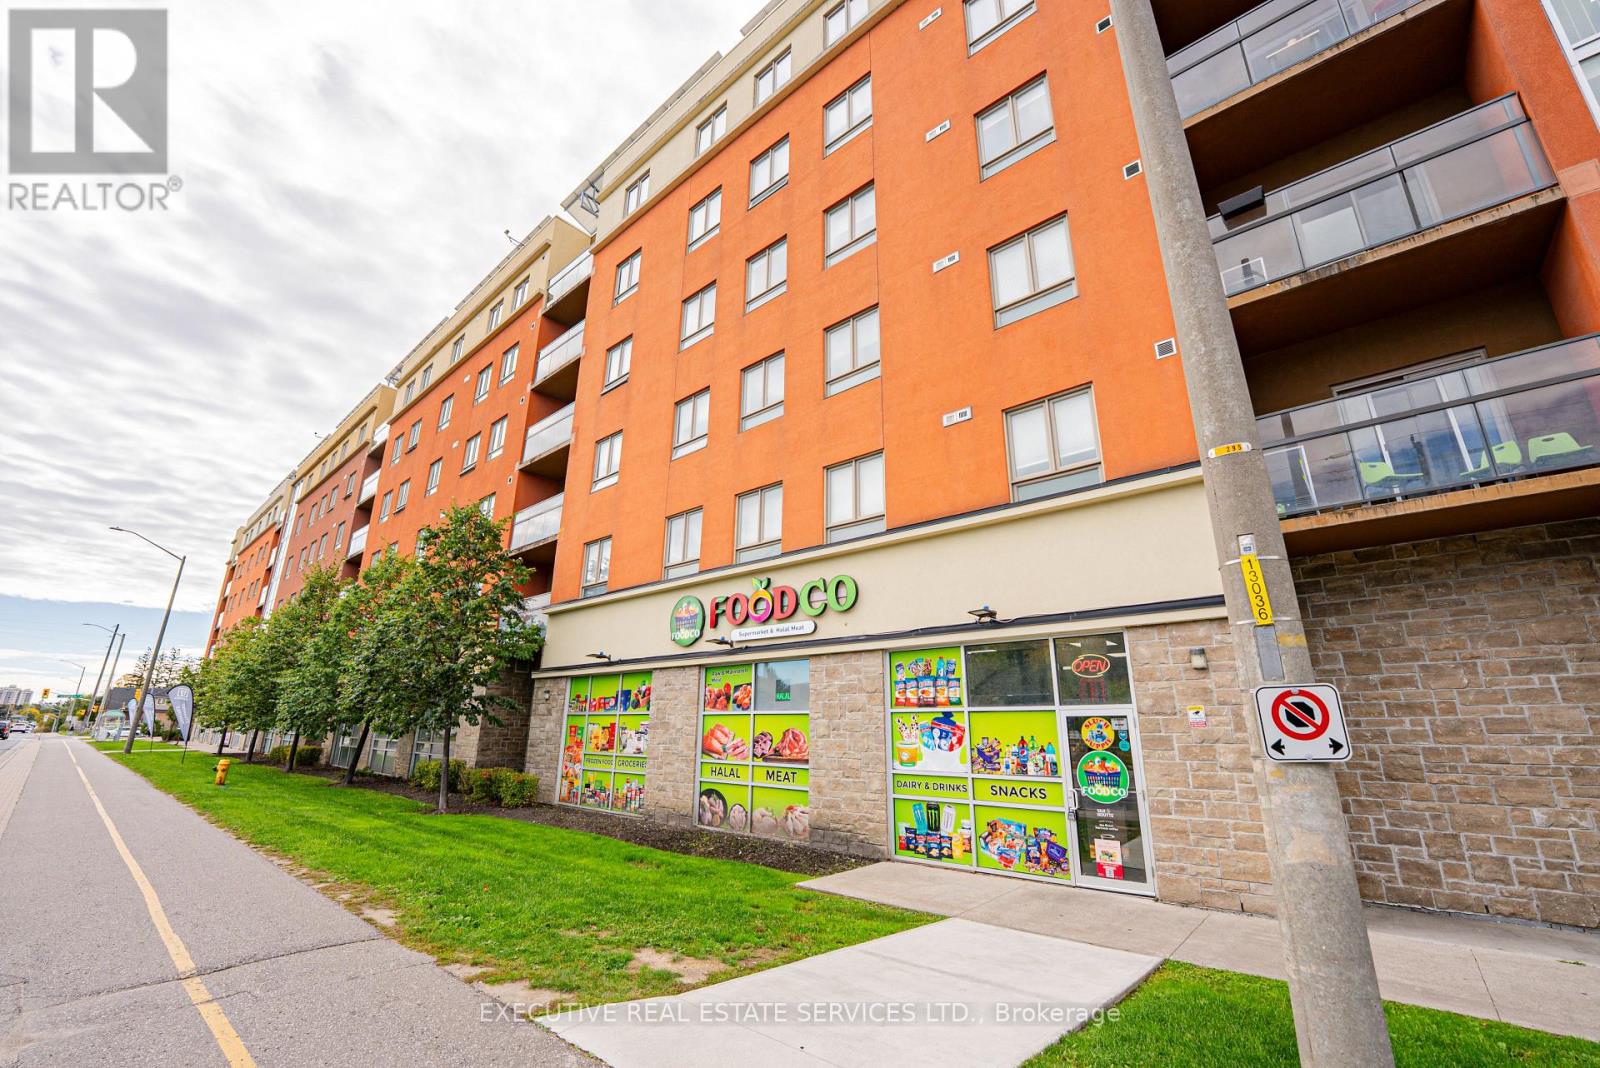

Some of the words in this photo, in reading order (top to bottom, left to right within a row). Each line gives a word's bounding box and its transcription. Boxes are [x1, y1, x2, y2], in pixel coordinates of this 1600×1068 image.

[1227, 444, 1242, 453] 295
[1246, 558, 1269, 621] 13036
[709, 574, 859, 629] FOODCO
[671, 629, 701, 641] FOODCO
[738, 628, 769, 637] Supermarket
[776, 626, 790, 634] Halal
[791, 624, 805, 632] Meat
[1073, 659, 1107, 673] OPEN
[710, 766, 741, 780] HALAL
[765, 769, 798, 784] MEAT
[896, 780, 922, 790] DAIRY
[924, 782, 930, 790] &
[932, 782, 968, 793] DRINKS
[990, 784, 1047, 800] SNACKS
[1082, 786, 1127, 797] FOODCO
